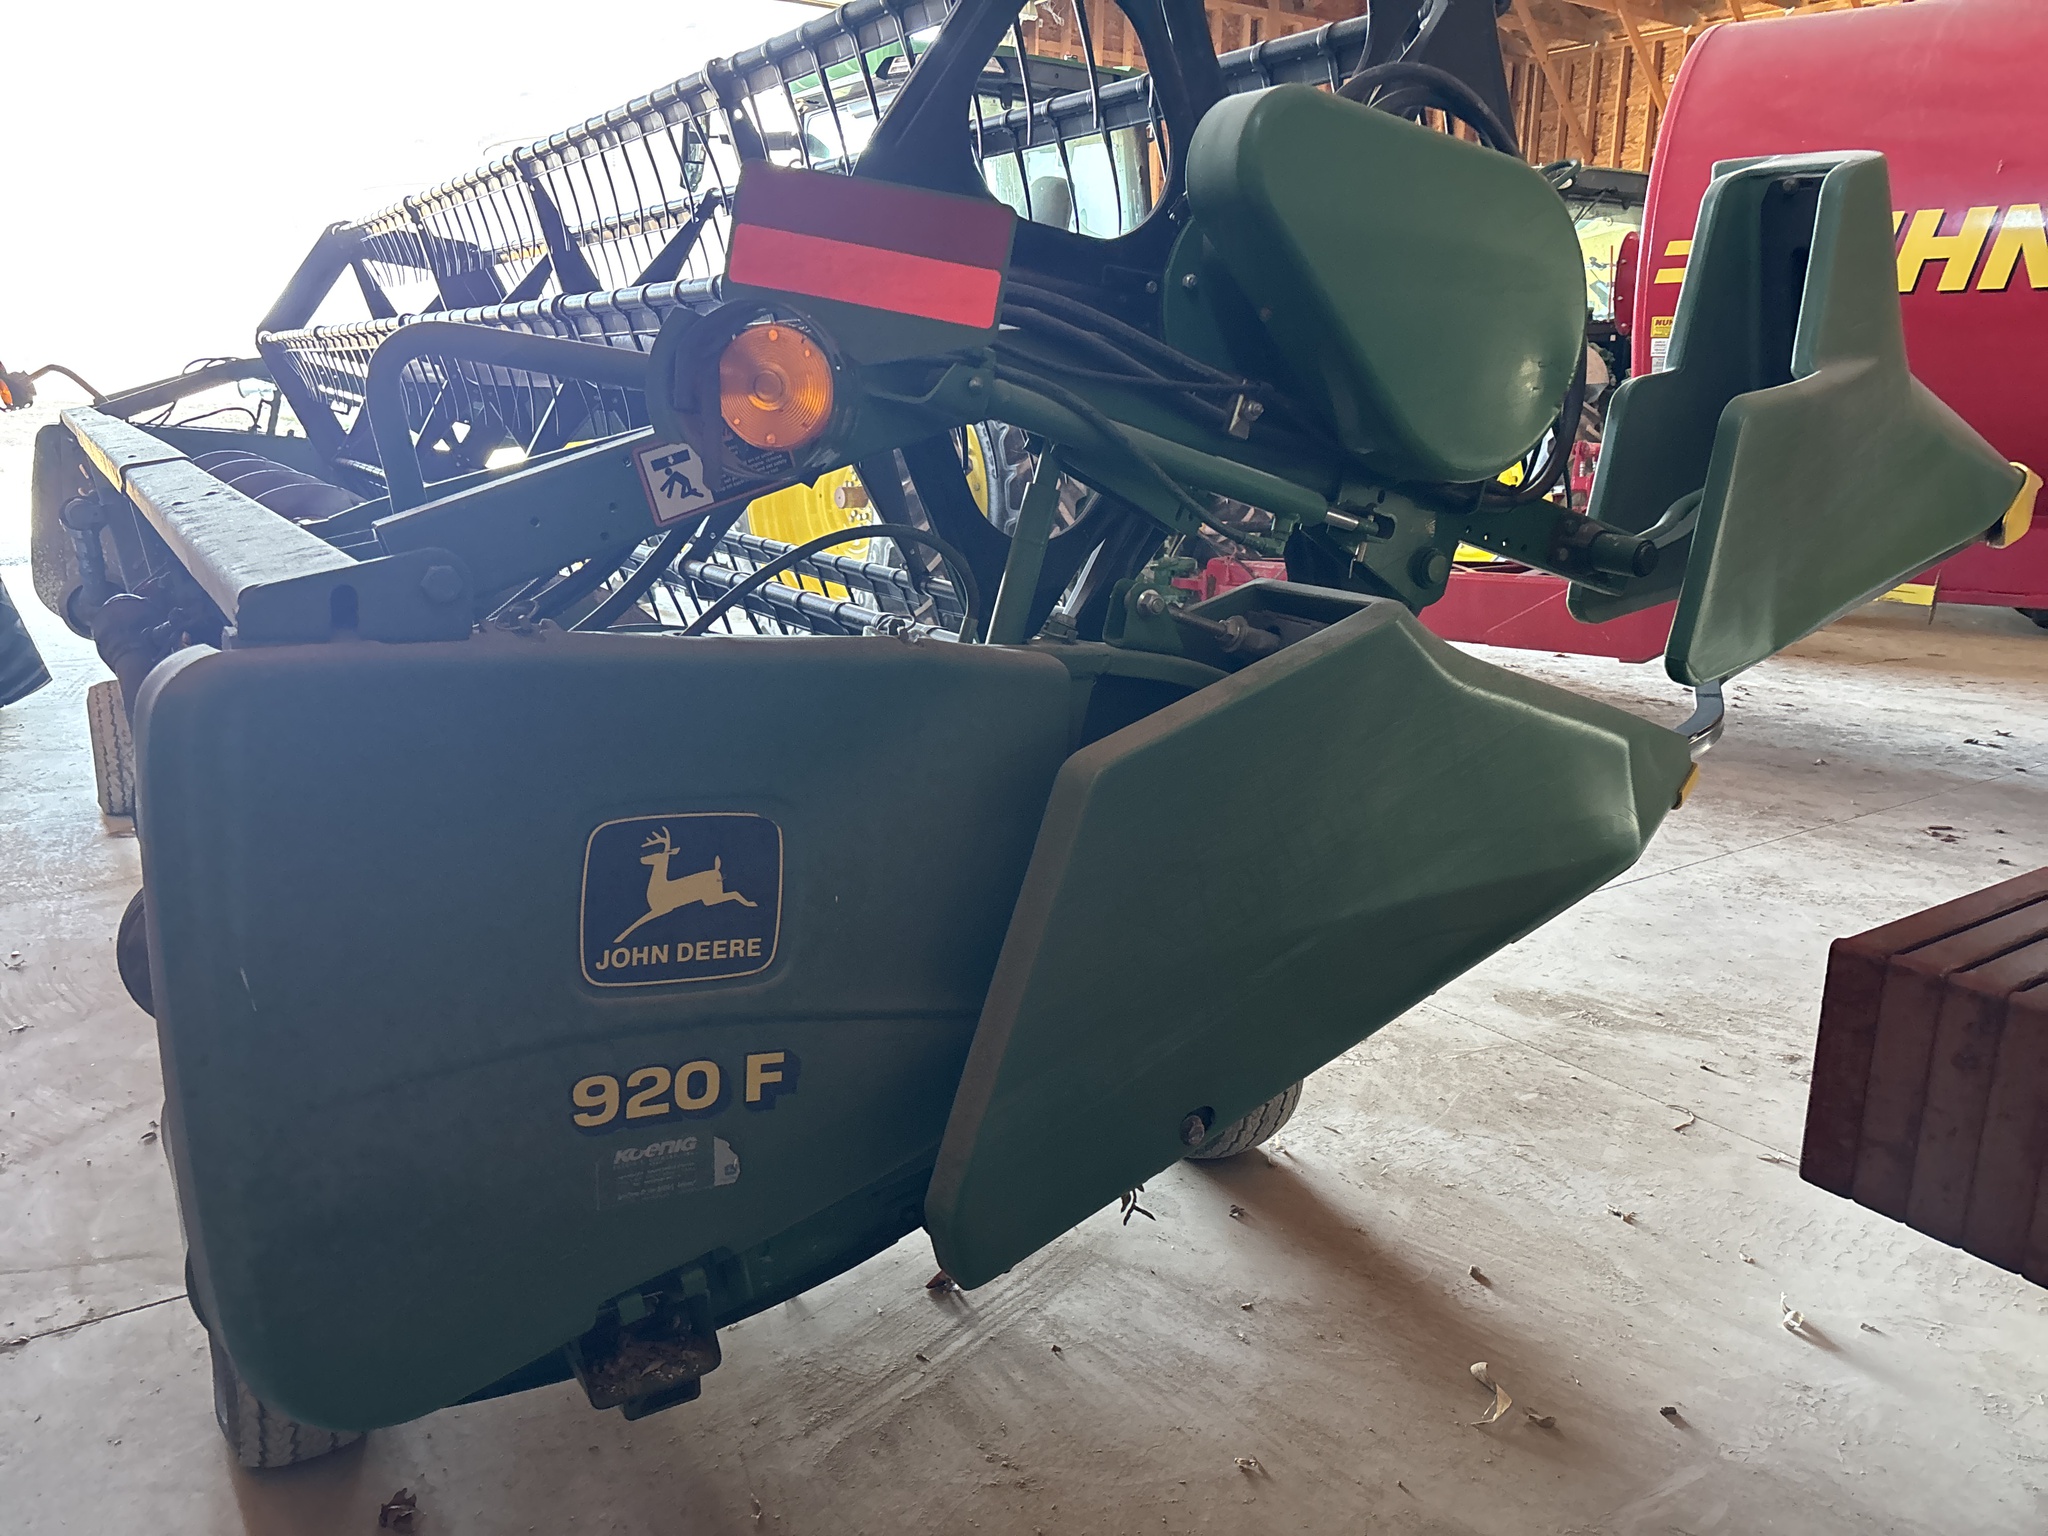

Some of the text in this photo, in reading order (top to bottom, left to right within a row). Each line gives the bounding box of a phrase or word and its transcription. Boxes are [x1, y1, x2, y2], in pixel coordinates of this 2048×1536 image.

[1892, 203, 2048, 293] HN
[595, 937, 763, 970] JOHN DEERE
[572, 1051, 785, 1128] 920 F
